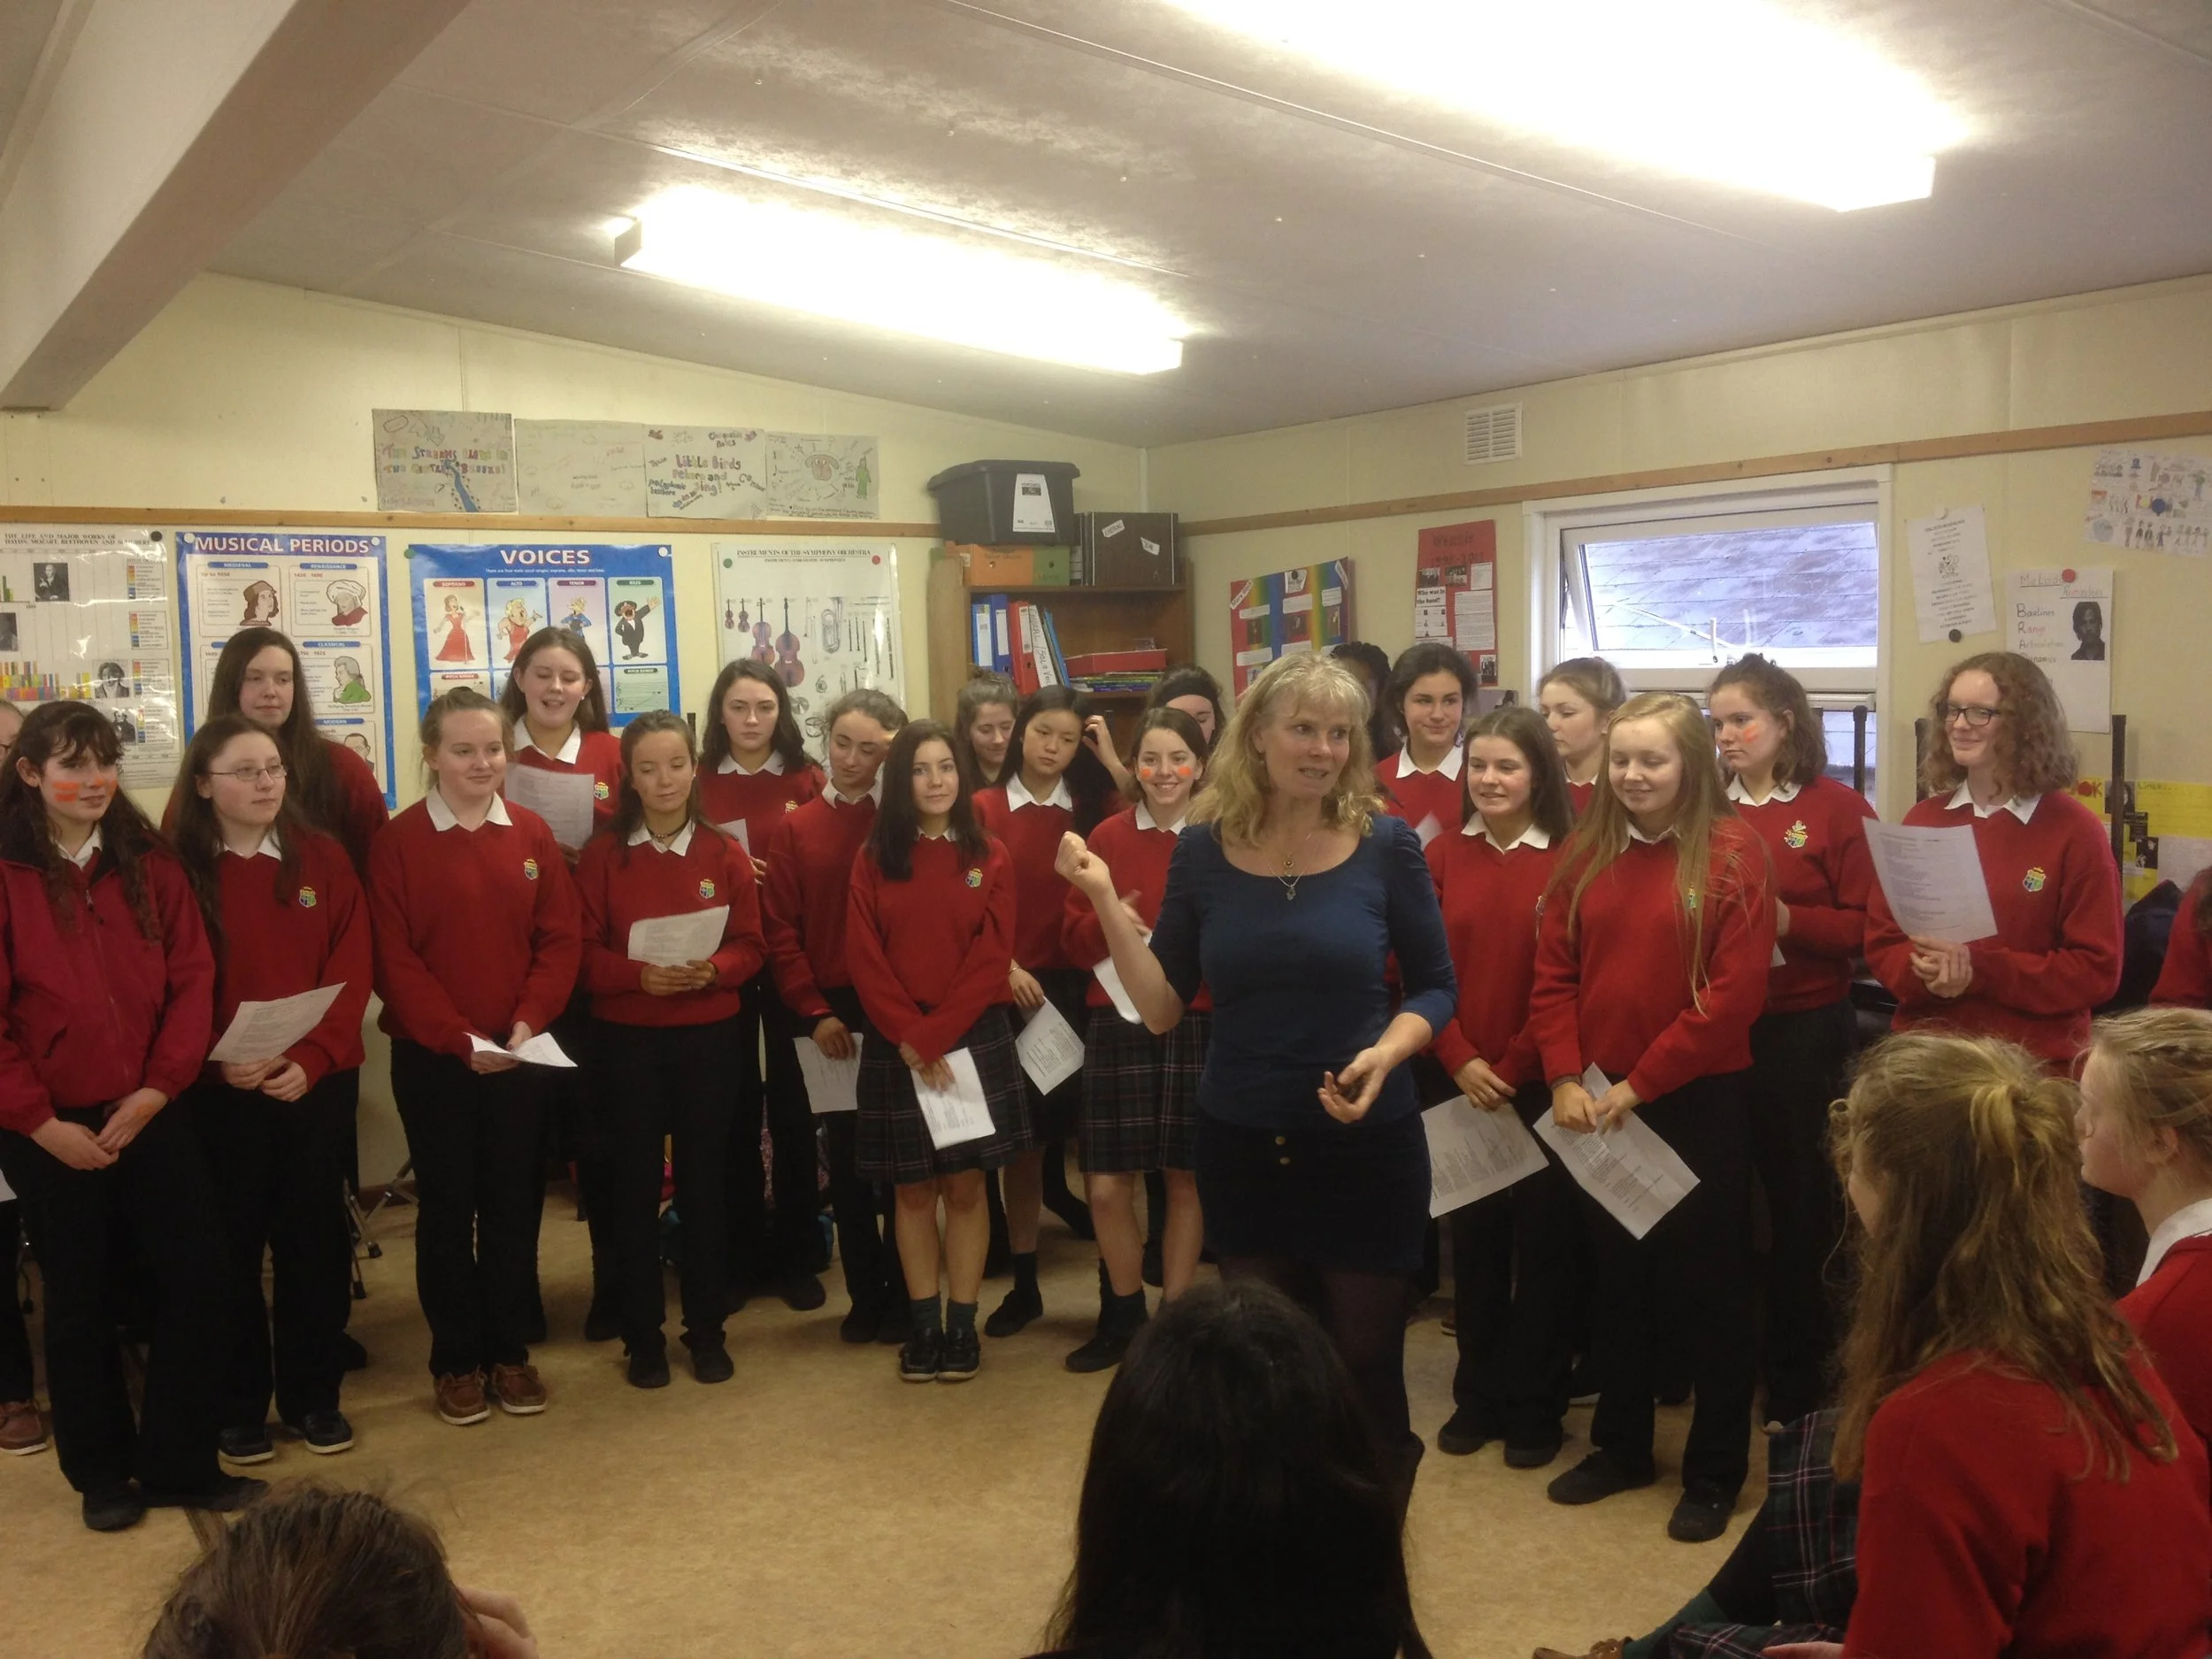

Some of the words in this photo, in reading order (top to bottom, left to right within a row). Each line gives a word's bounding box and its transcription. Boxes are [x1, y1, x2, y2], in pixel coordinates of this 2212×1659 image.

[195, 536, 284, 553] MUSICAL
[289, 538, 370, 554] PERIODS
[500, 549, 591, 565] VOICES
